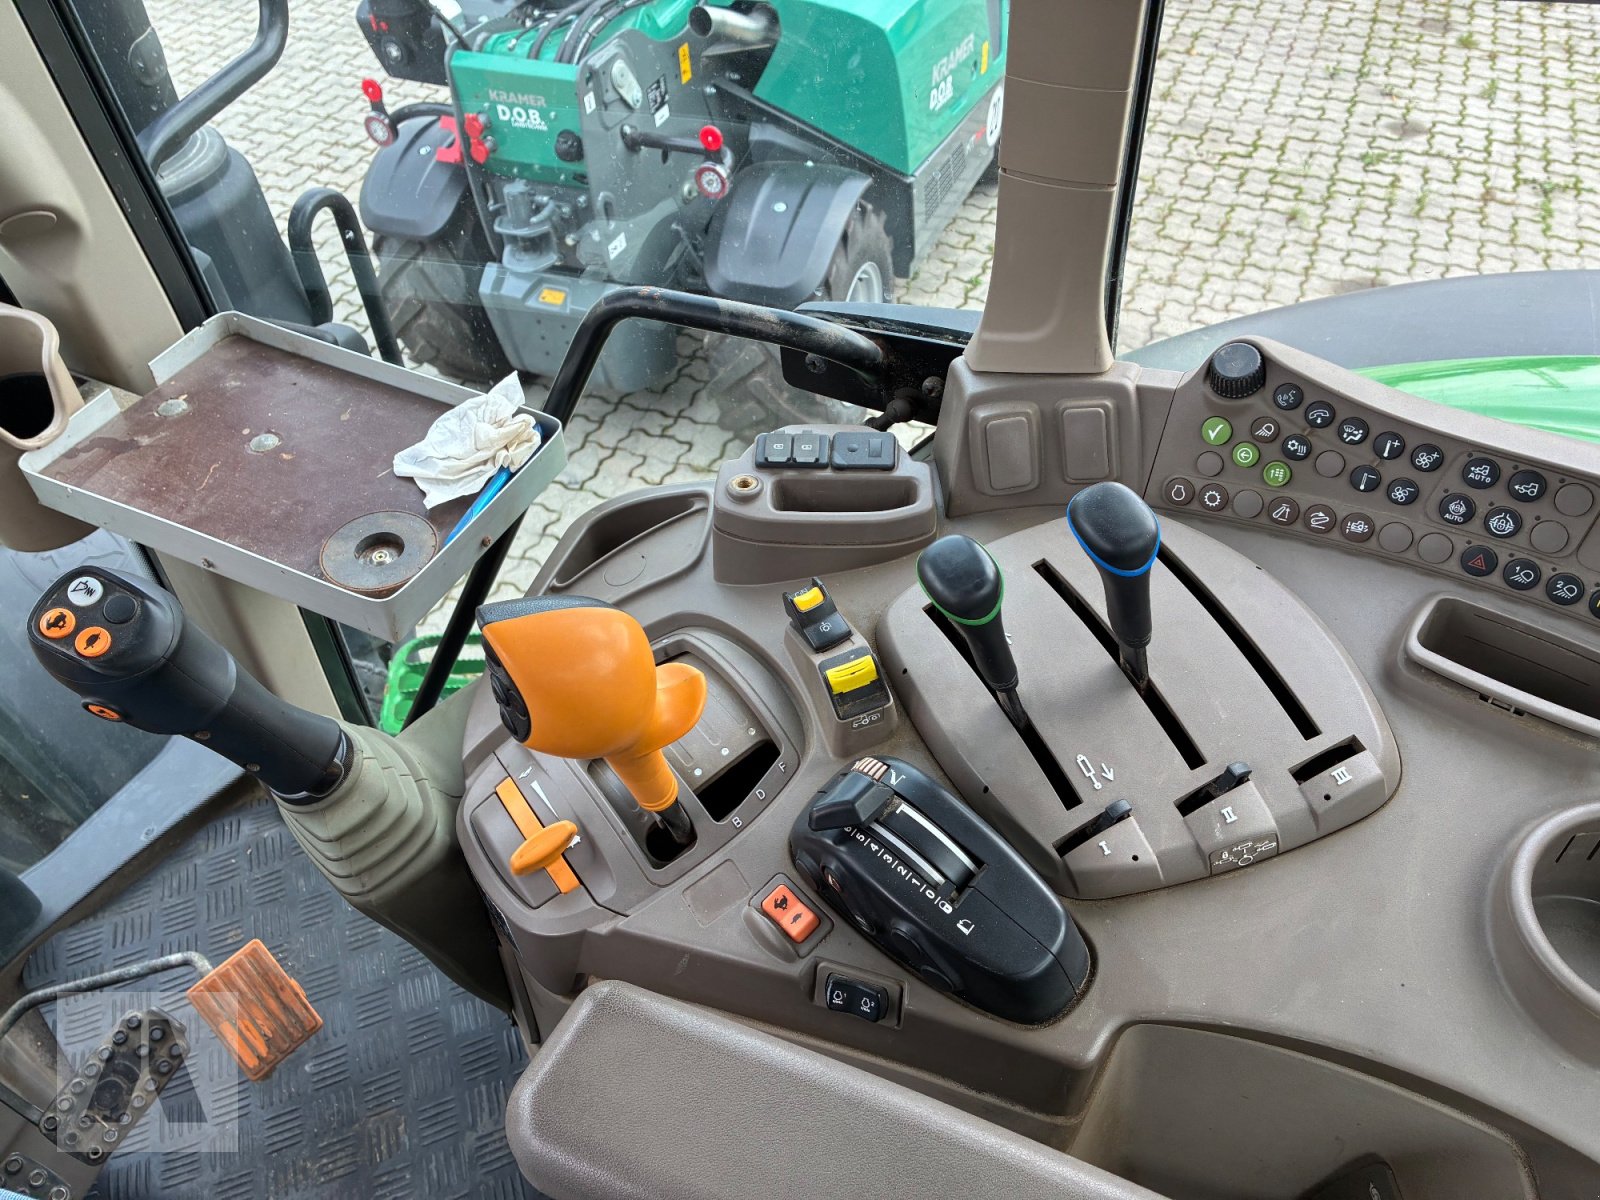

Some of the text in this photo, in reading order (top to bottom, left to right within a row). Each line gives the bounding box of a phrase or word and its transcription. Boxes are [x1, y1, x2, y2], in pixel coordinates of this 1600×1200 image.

[931, 33, 975, 87] KRAMER
[488, 88, 547, 107] KRAMER
[1467, 472, 1491, 483] AUTO
[1443, 513, 1464, 523] AUTO
[1556, 580, 1564, 588] 2
[1331, 766, 1352, 786] III
[731, 761, 787, 828] B D F
[1220, 806, 1238, 824] II
[855, 833, 865, 842] 5
[869, 842, 879, 852] 4
[882, 853, 893, 863] 3
[896, 865, 908, 876] 2
[911, 877, 921, 886] 1
[925, 889, 936, 899] 0
